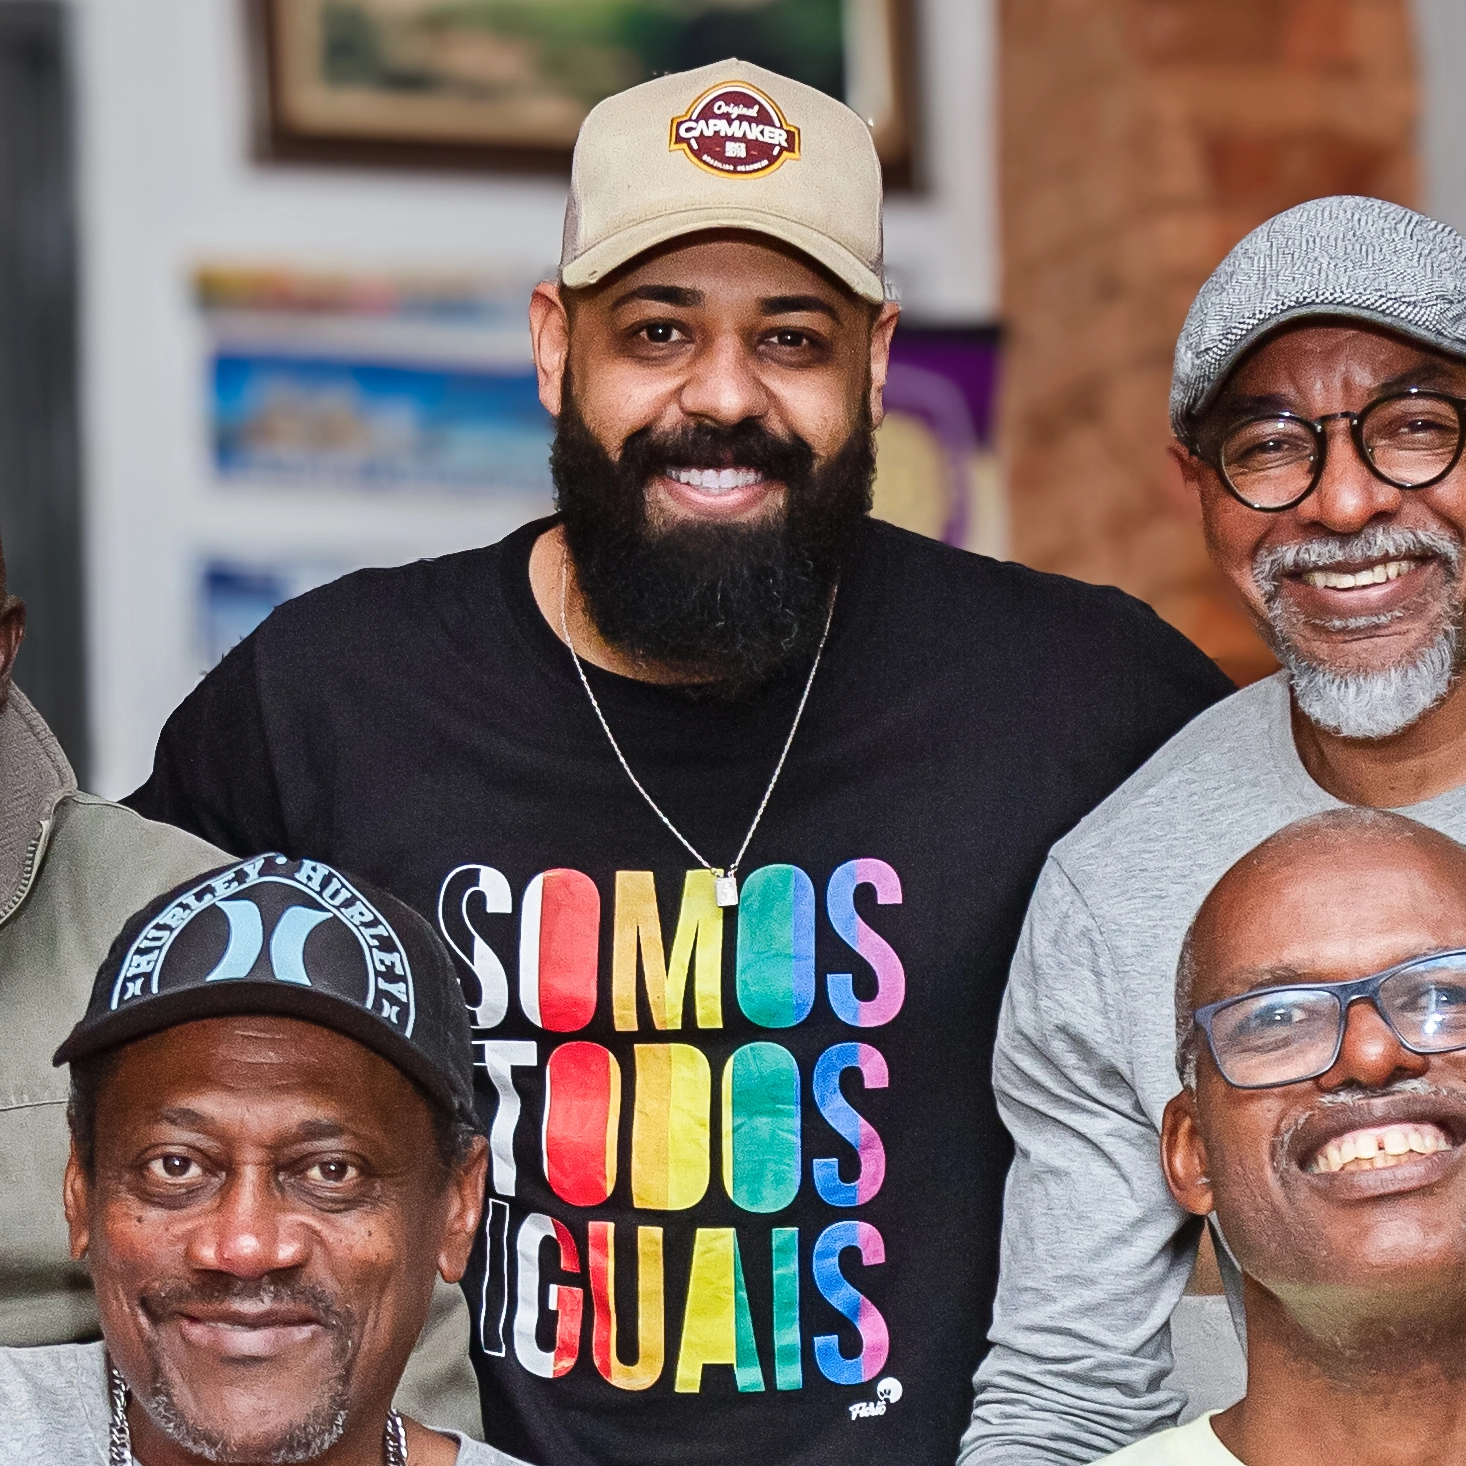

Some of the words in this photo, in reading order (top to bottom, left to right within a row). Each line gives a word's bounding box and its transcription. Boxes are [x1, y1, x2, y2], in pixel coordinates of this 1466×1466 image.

[679, 119, 788, 147] CAPMAKER
[713, 101, 759, 119] Original
[126, 858, 264, 978] HURLEY
[294, 859, 408, 1002] HURLEY
[438, 858, 905, 1033] SOMOS
[472, 1040, 889, 1213] TODOS
[480, 1198, 889, 1393] IGUAIS
